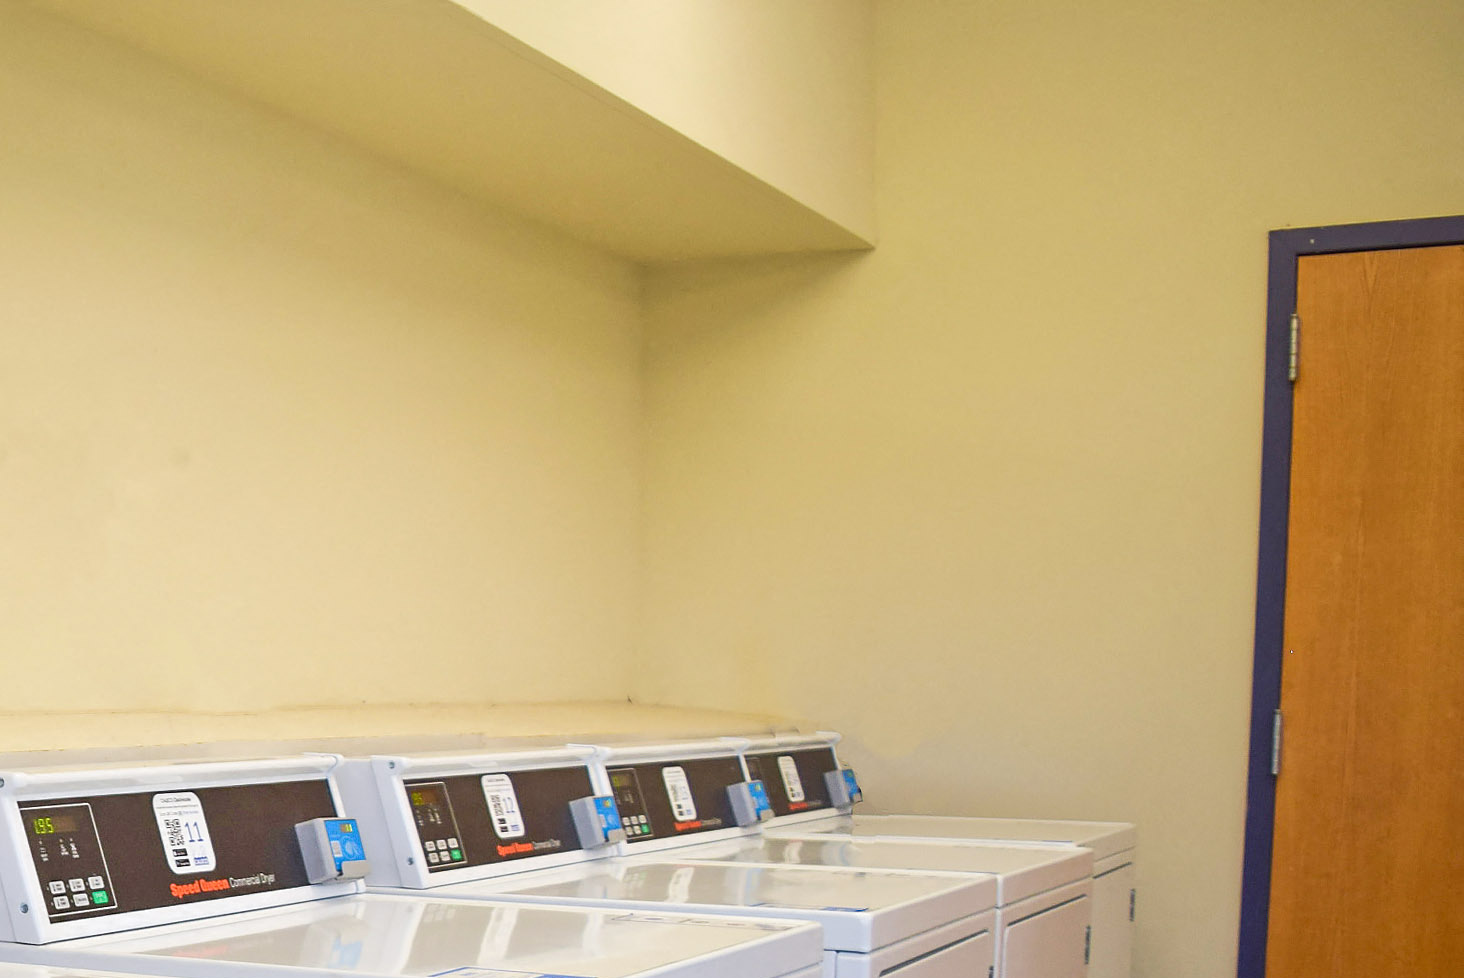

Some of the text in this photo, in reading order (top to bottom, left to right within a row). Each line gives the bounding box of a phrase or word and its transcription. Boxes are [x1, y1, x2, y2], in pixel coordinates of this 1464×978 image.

[185, 821, 204, 843] 11
[169, 879, 201, 899] Speed
[199, 878, 231, 892] Queen
